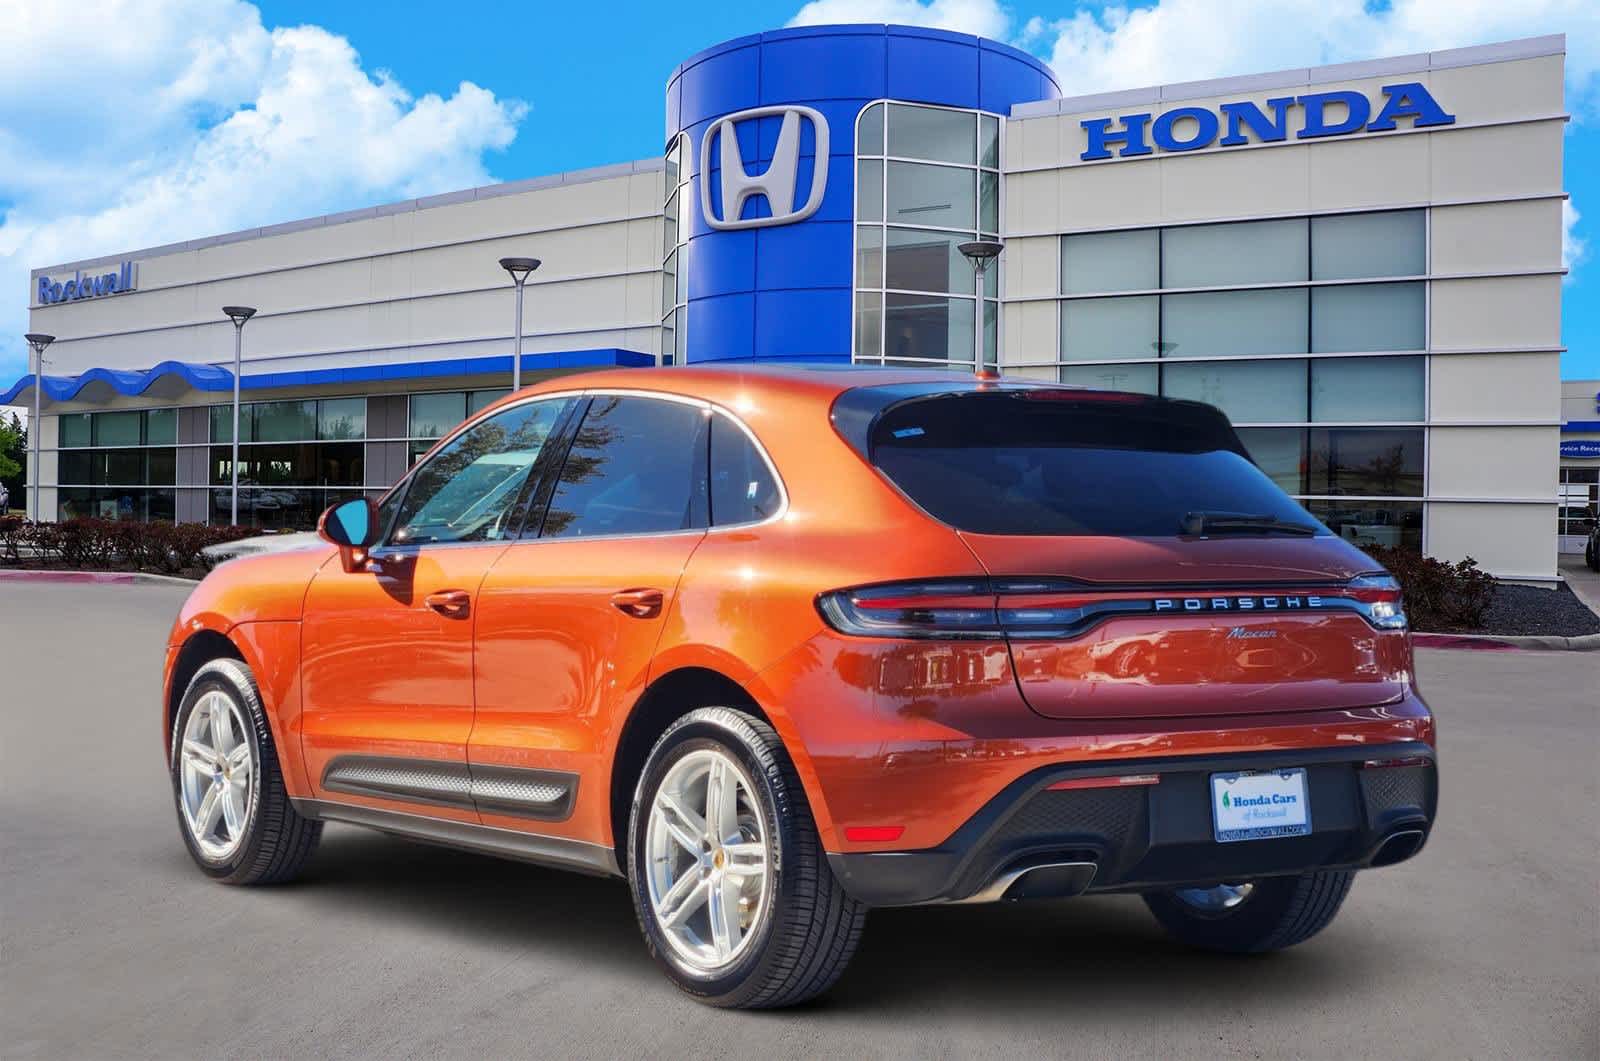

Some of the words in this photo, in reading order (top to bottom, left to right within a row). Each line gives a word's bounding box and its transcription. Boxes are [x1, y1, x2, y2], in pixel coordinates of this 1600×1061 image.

[1080, 82, 1456, 160] HONDA
[38, 260, 132, 304] Rockwall
[1155, 596, 1322, 611] PORSCHE
[1226, 627, 1277, 639] Macan
[1233, 794, 1271, 807] Honda
[1272, 793, 1297, 804] Cars
